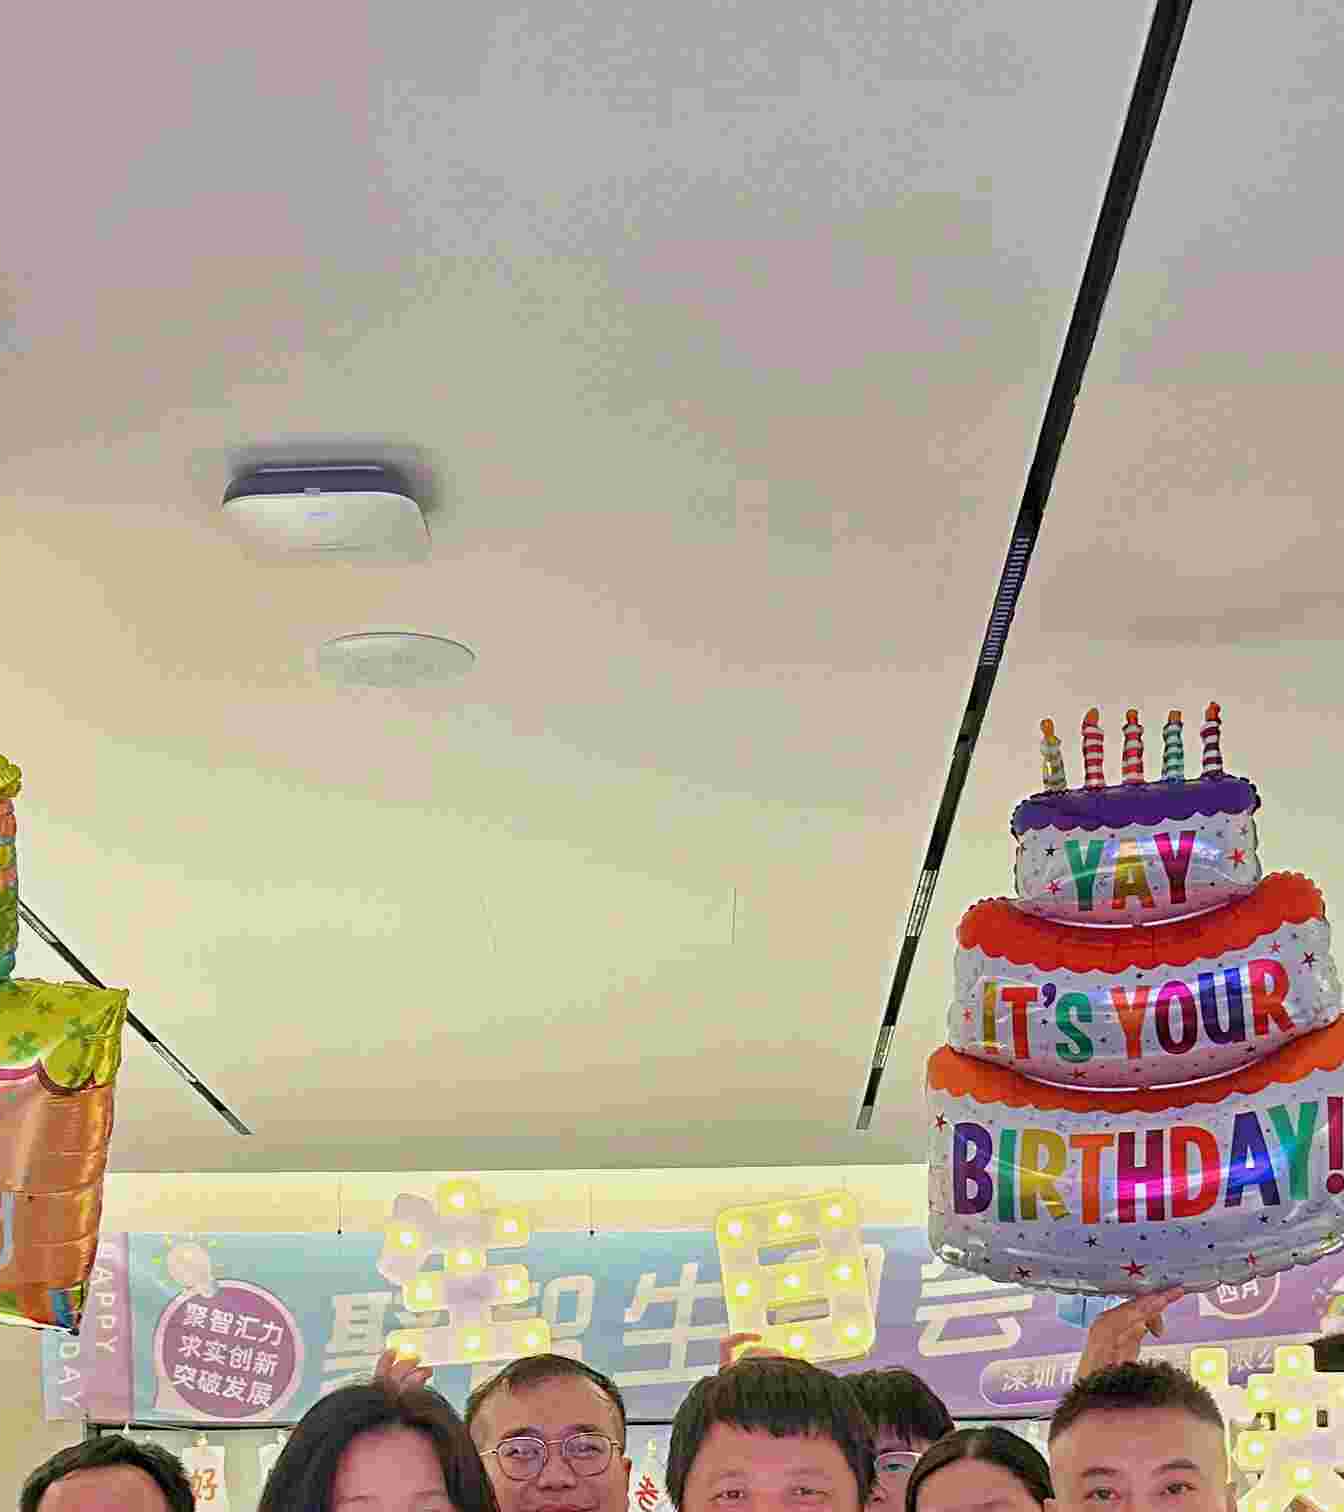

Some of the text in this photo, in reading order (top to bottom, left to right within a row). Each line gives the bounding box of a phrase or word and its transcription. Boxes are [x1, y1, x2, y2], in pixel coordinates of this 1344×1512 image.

[1064, 831, 1196, 911] YAY
[981, 959, 1296, 1063] IT'S YOUR
[952, 1096, 1344, 1224] BIRTHDAY!
[183, 1303, 284, 1346] 聚智汇力
[173, 1364, 274, 1407] 突破发展
[178, 1335, 279, 1377] 求实创新
